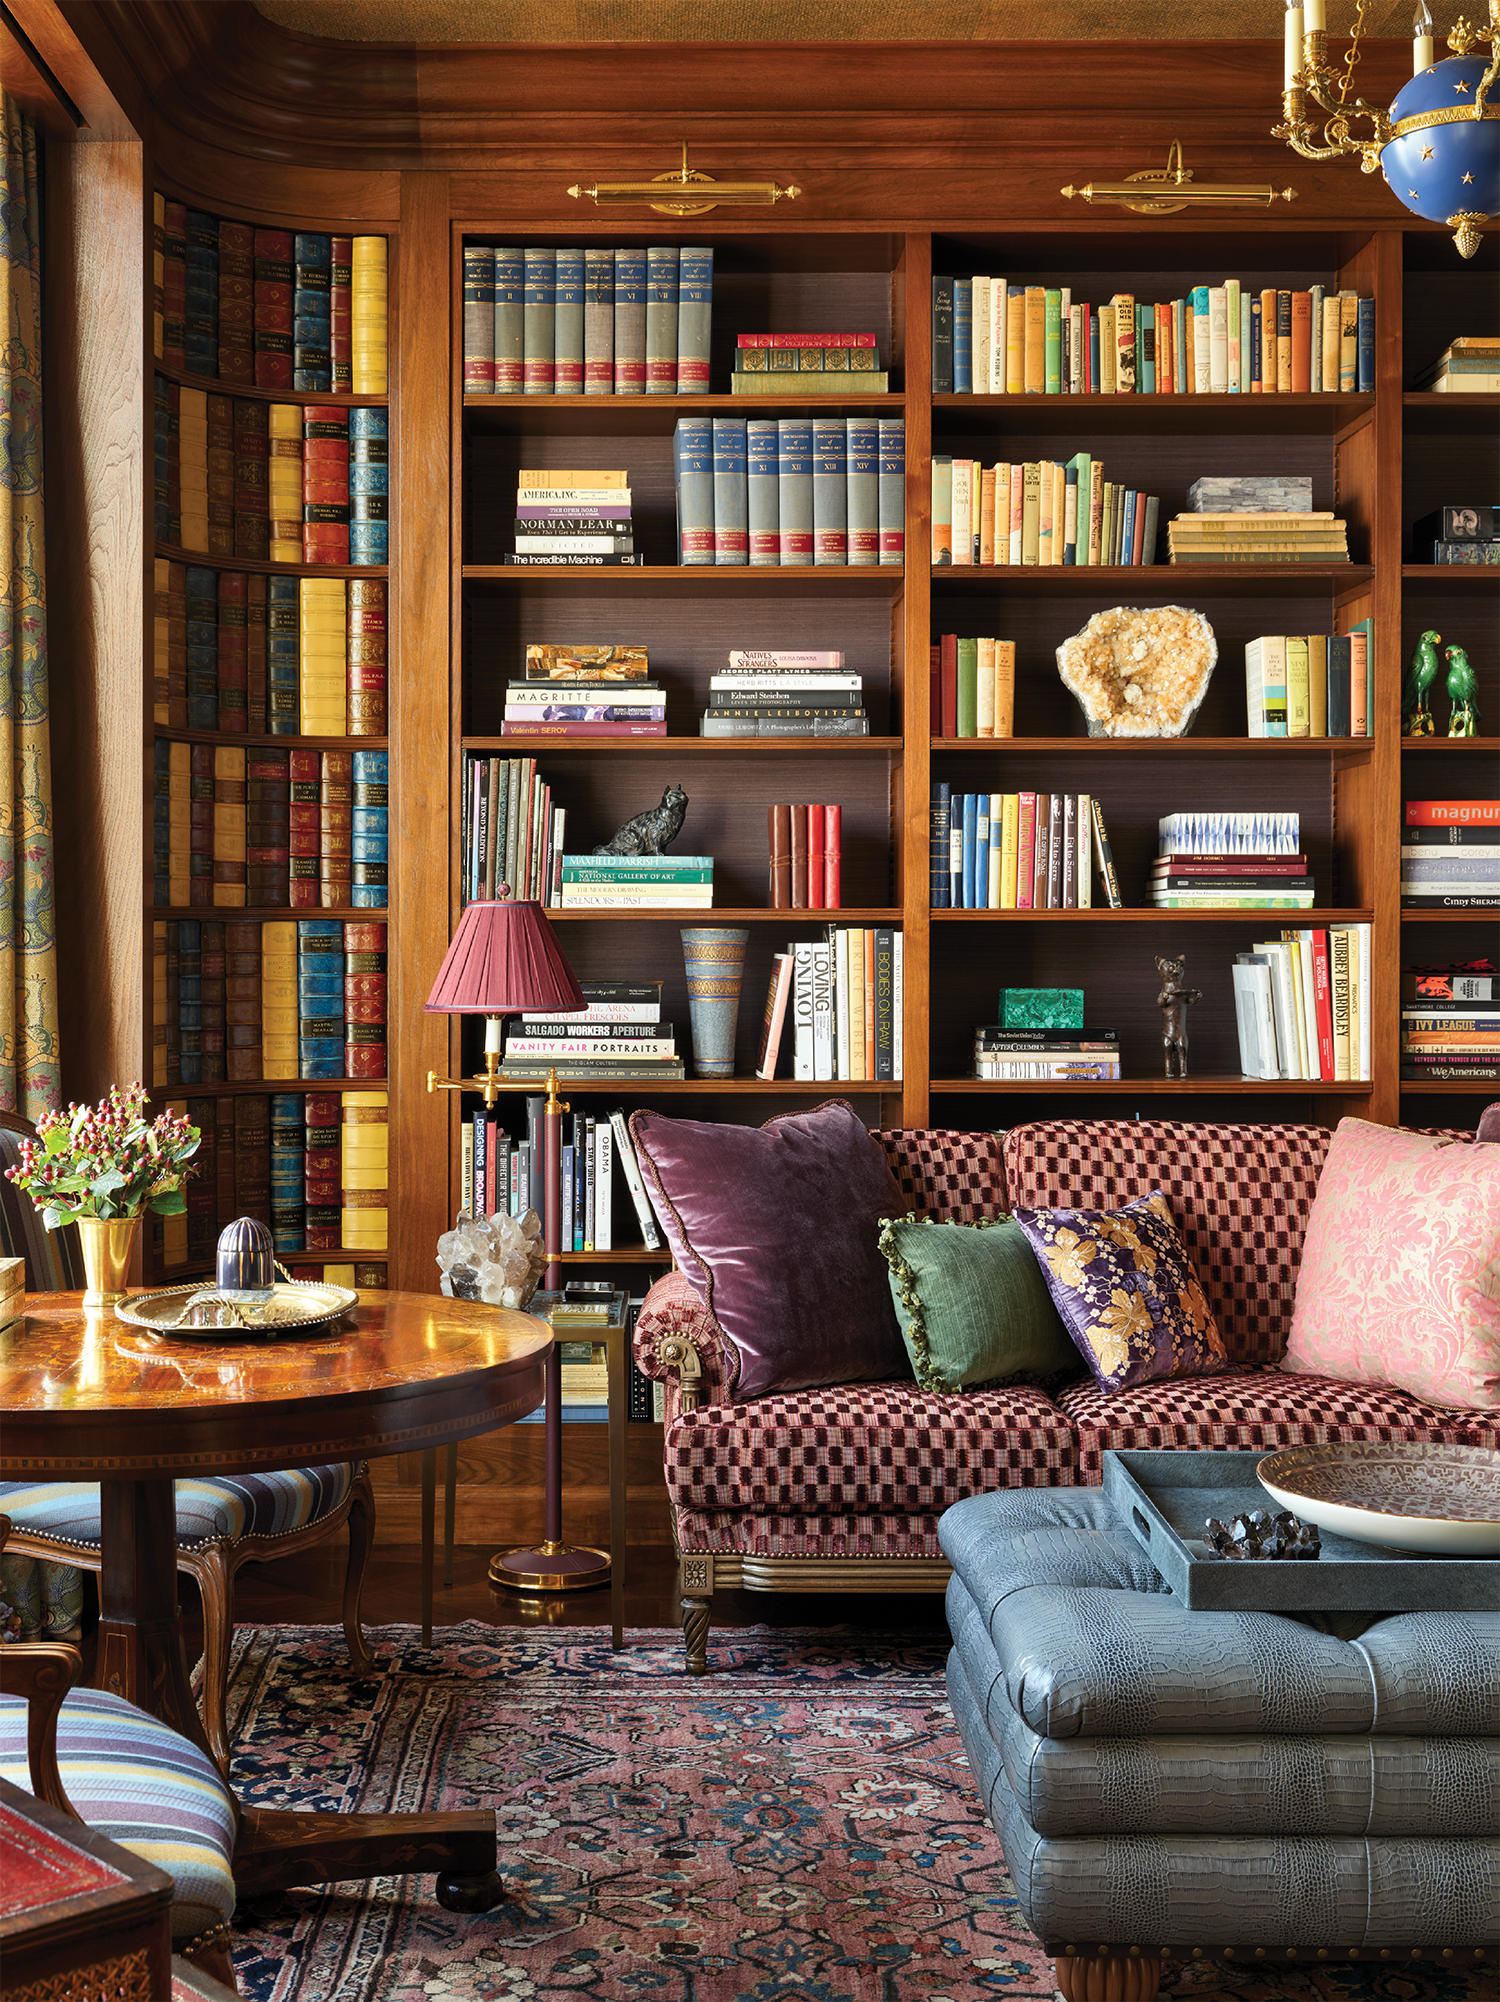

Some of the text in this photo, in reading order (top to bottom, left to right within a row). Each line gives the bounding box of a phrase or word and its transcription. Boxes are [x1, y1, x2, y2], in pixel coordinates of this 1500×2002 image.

[520, 520, 614, 529] NORMAN LEAR
[512, 556, 603, 564] The Incredible Machine
[517, 693, 591, 701] MAGRITTE
[1411, 848, 1491, 858] benu corey
[570, 857, 616, 865] MAXFIELD
[619, 857, 659, 866] PARRISH
[1019, 858, 1031, 898] Surrender
[814, 952, 829, 1012] LOVING
[1335, 936, 1348, 1037] AUBREY BEARDSLEY
[797, 950, 812, 1028] LOVING
[853, 941, 864, 1058] BRUCE WEBER
[878, 953, 890, 1049] BODIES ON RAW
[866, 1001, 874, 1024] Comes
[525, 1026, 656, 1036] SALGADO WORKERS APERTURE
[1416, 1021, 1475, 1030] IVY LEAGUE
[866, 1026, 874, 1041] Love
[593, 1044, 658, 1052] PORTRAITS
[1012, 1043, 1044, 1051] COLUMBUS
[1443, 1067, 1496, 1079] Americans
[476, 1119, 485, 1166] DESIGNING
